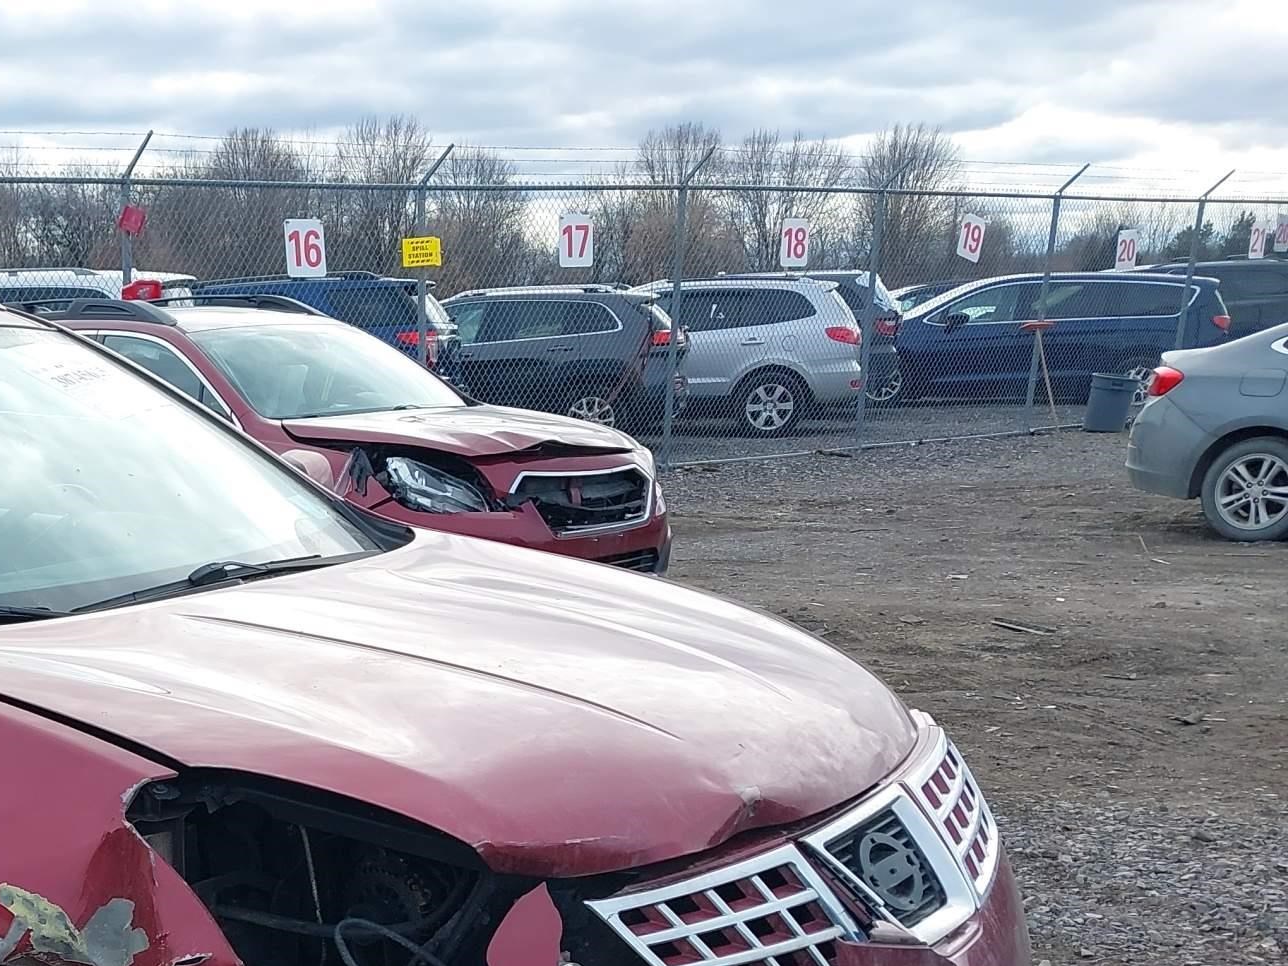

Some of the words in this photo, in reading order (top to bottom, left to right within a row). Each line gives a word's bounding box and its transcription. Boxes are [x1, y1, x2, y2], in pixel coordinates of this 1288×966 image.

[288, 229, 322, 267] 16
[562, 224, 589, 258] 17
[783, 227, 806, 259] 18
[963, 221, 982, 254] 19
[1117, 238, 1135, 262] 20
[1250, 227, 1266, 253] 21
[407, 252, 433, 260] STATION
